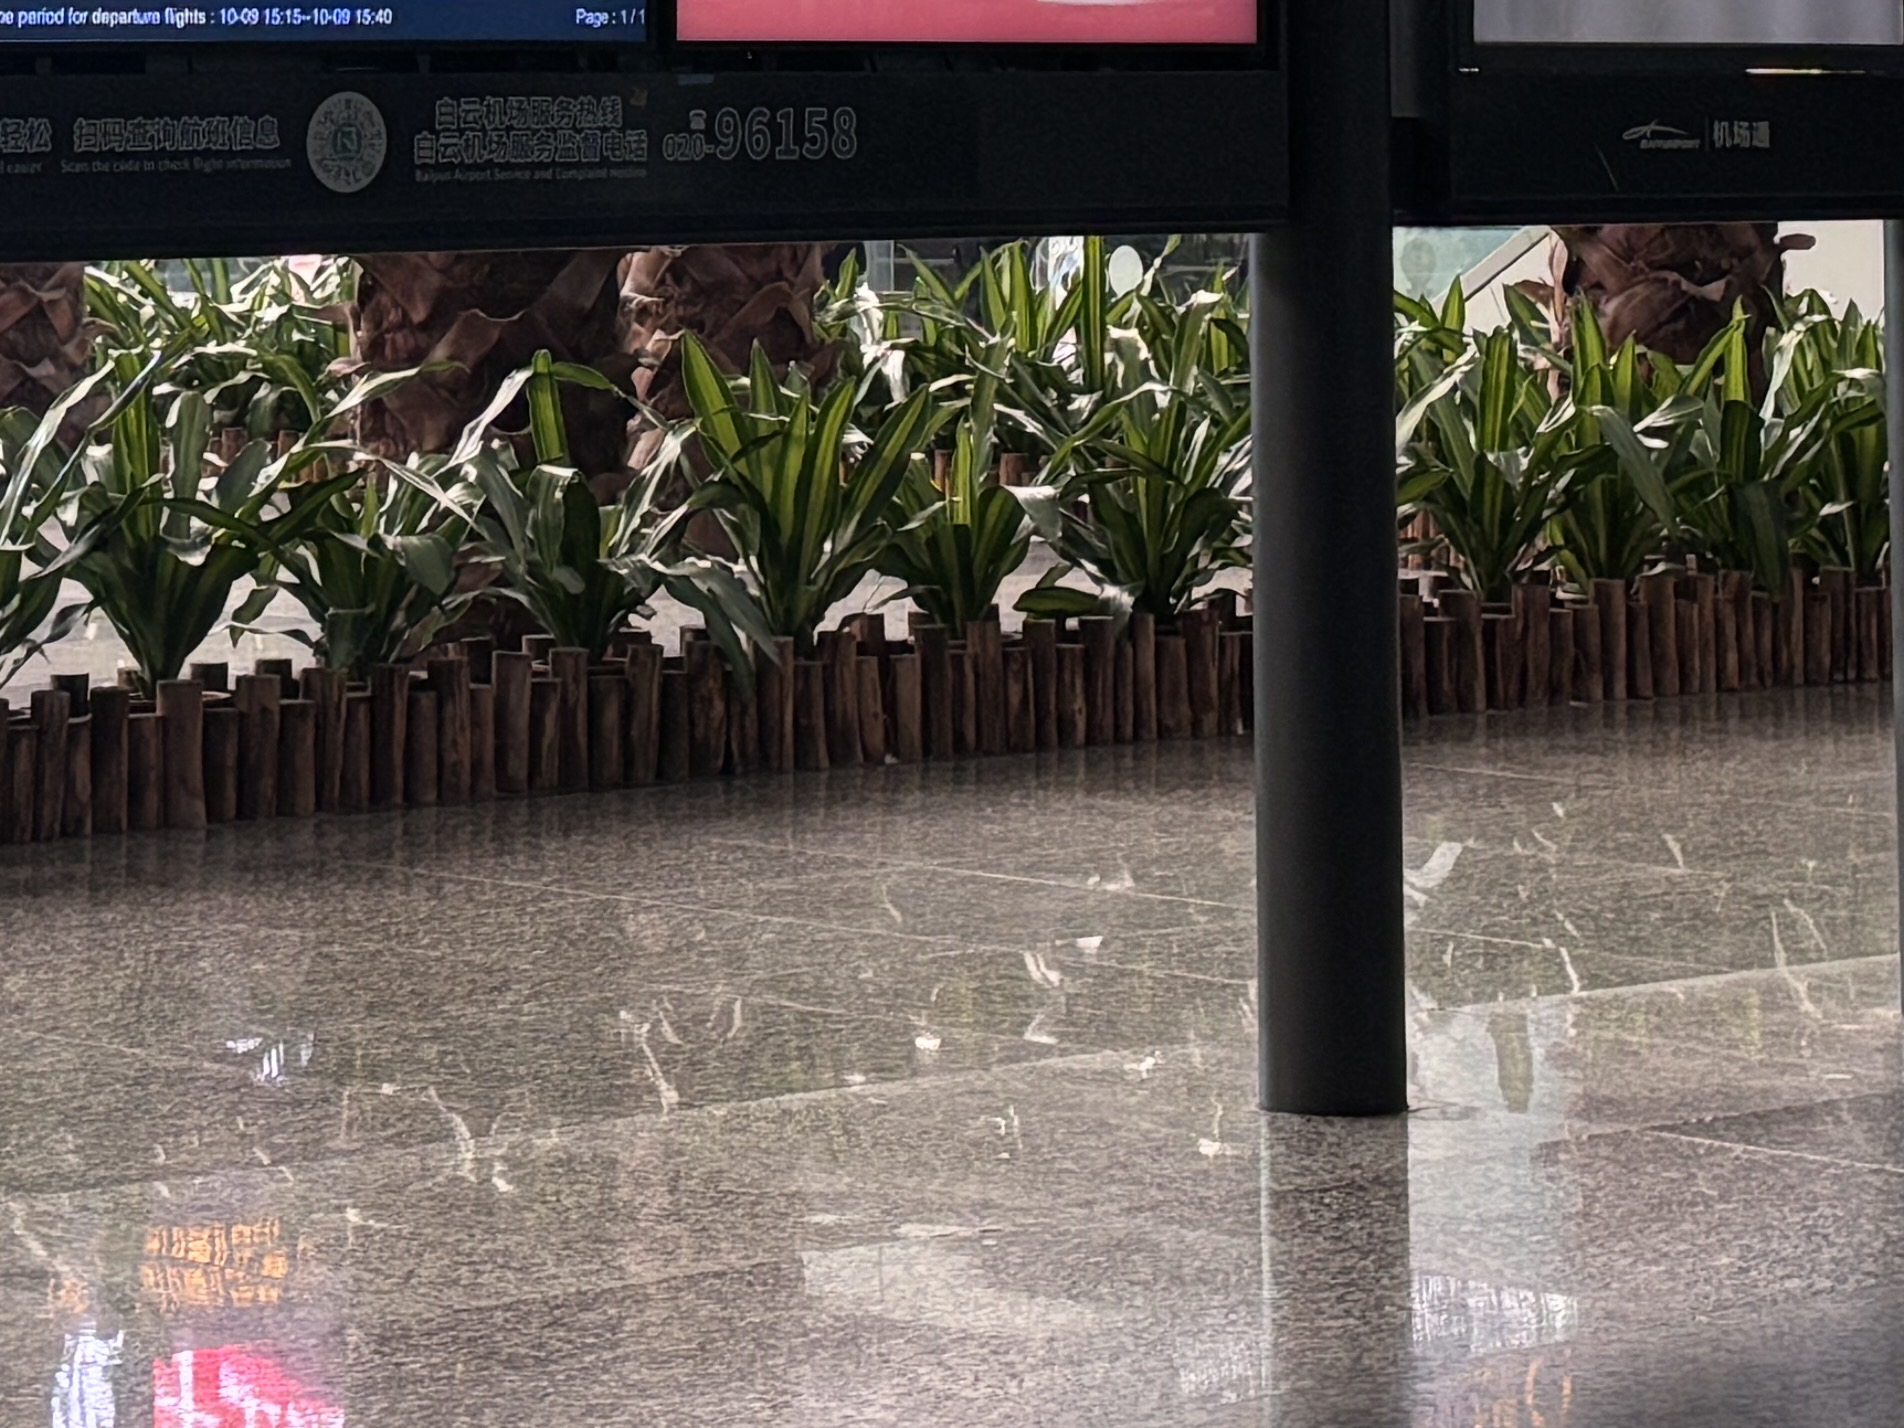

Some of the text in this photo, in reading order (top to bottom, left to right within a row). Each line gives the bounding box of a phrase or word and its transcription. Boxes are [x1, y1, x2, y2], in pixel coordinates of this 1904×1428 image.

[435, 96, 623, 129] 白云机场服务热线
[73, 116, 281, 153] 扫码查询航班信息
[414, 130, 648, 164] 白云机场服务监督电话
